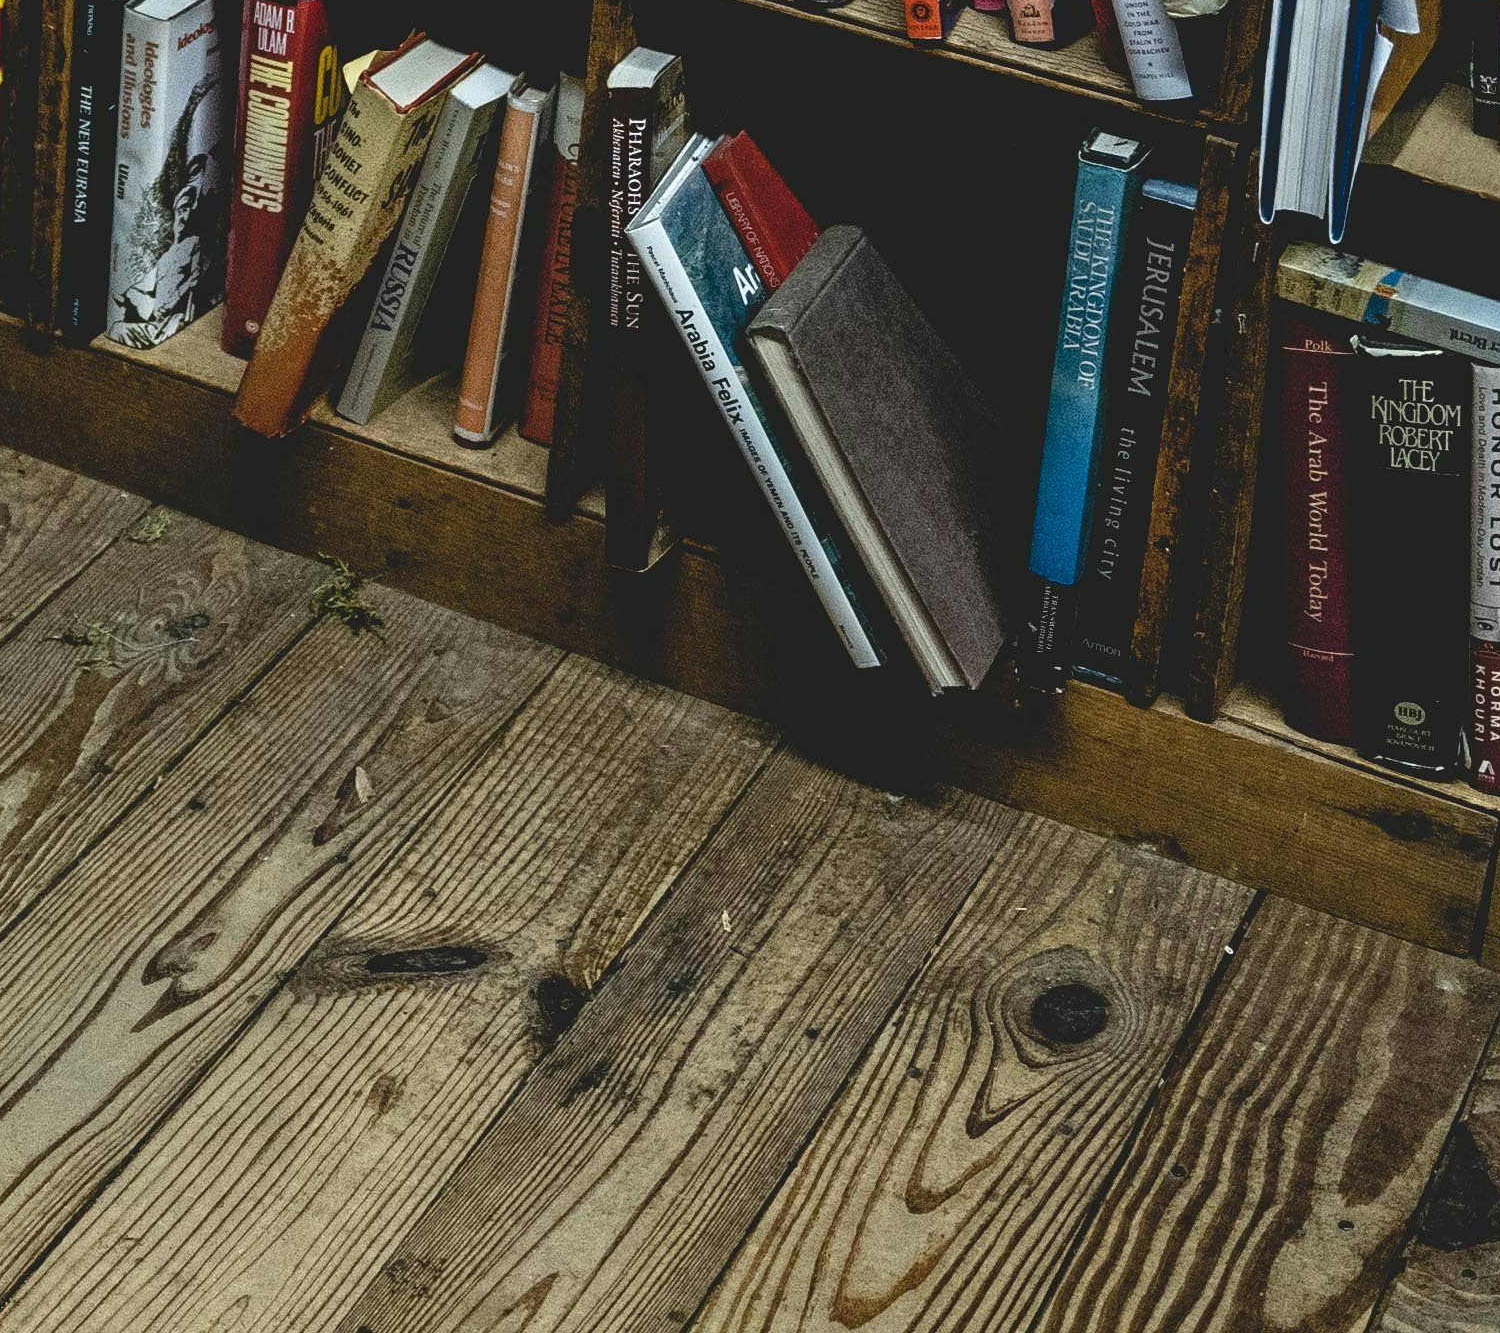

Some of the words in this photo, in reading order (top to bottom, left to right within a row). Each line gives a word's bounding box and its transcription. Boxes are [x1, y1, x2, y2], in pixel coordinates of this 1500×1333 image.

[140, 40, 158, 130] Ideologies
[241, 90, 291, 214] COMMUNISTS
[370, 242, 417, 331] RUSSIA
[1127, 237, 1175, 396] JERUSALEM
[675, 309, 716, 373] Arabia
[711, 374, 745, 427] Felix
[1308, 382, 1328, 424] The
[1372, 396, 1461, 427] KINGDOM
[1308, 430, 1328, 483] Arab
[1309, 490, 1329, 552] World
[1308, 560, 1329, 622] Today
